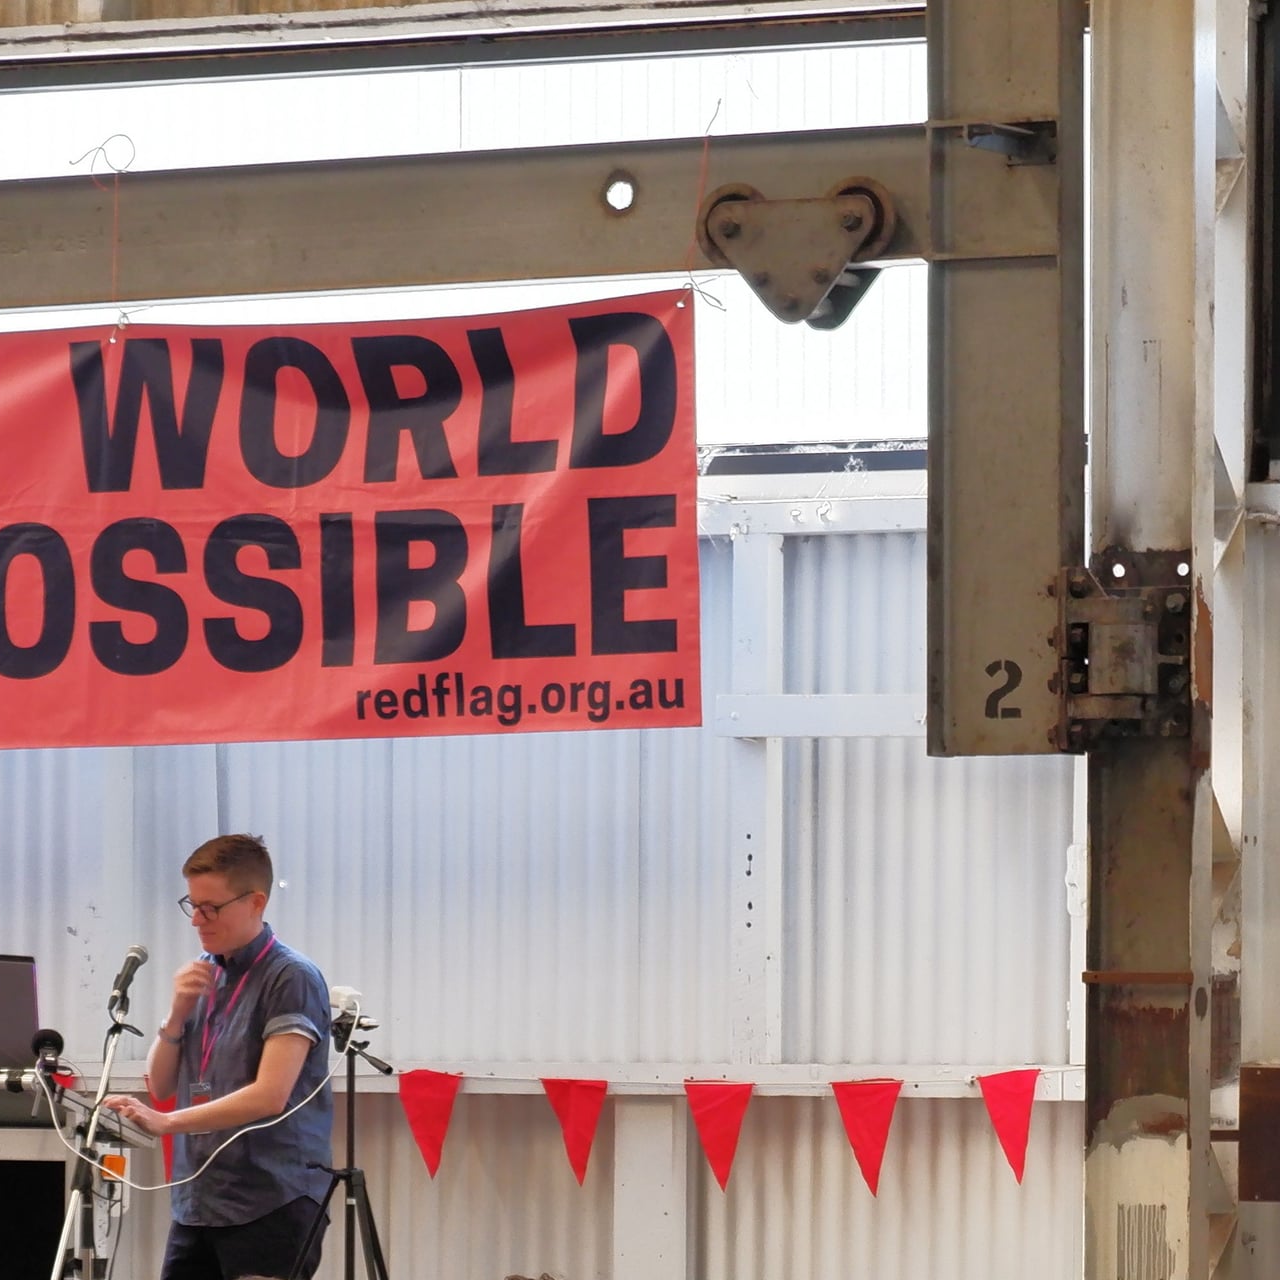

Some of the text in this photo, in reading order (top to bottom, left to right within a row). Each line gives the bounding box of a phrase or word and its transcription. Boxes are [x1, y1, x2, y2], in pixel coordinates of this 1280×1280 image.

[69, 311, 678, 493] WORLD
[356, 671, 685, 727] redflag.org.au
[985, 660, 1022, 719] 2
